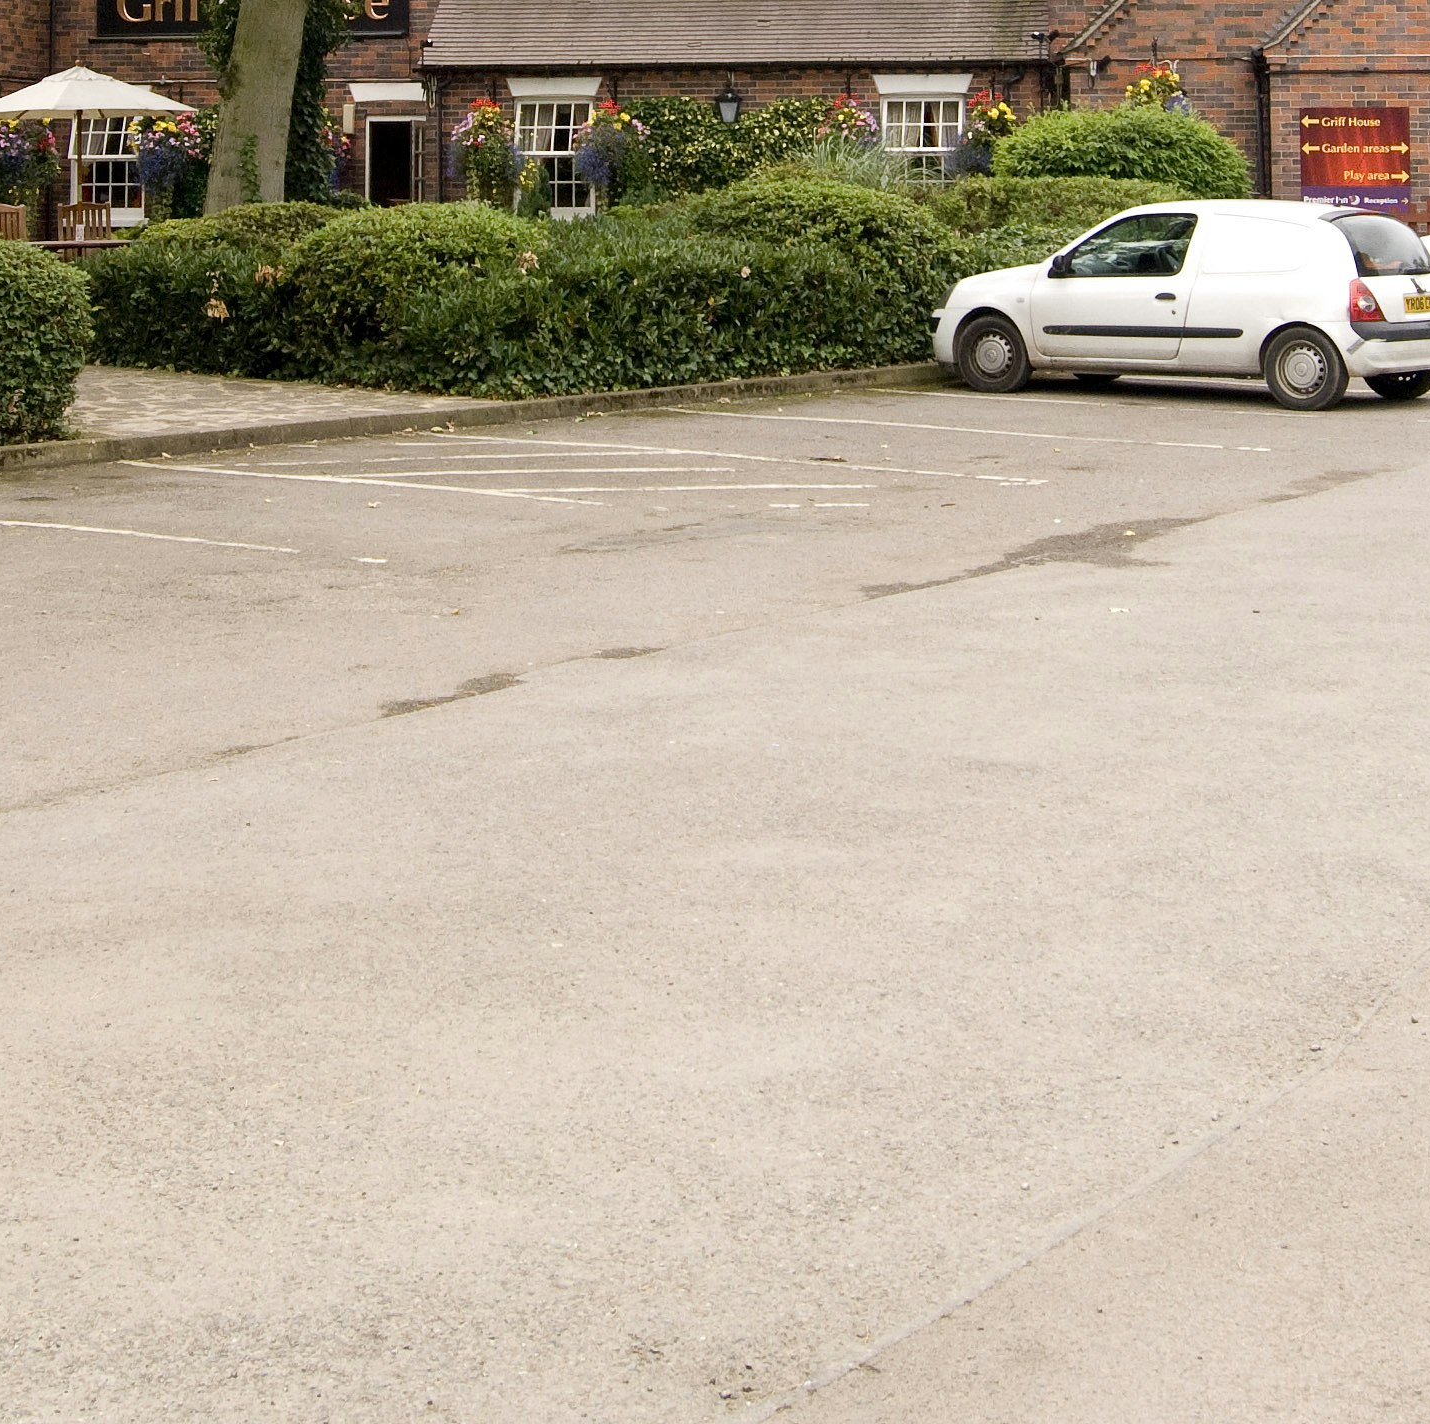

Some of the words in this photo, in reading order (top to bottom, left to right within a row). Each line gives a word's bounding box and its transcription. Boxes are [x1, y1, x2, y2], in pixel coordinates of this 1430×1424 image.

[1321, 117, 1346, 127] Griff
[1348, 117, 1381, 127] House
[1321, 142, 1360, 153] Garden
[1362, 144, 1390, 153] areas
[1343, 170, 1364, 182] Play
[1367, 172, 1390, 180] area
[1303, 196, 1334, 205] Premier
[1364, 197, 1398, 205] Reception
